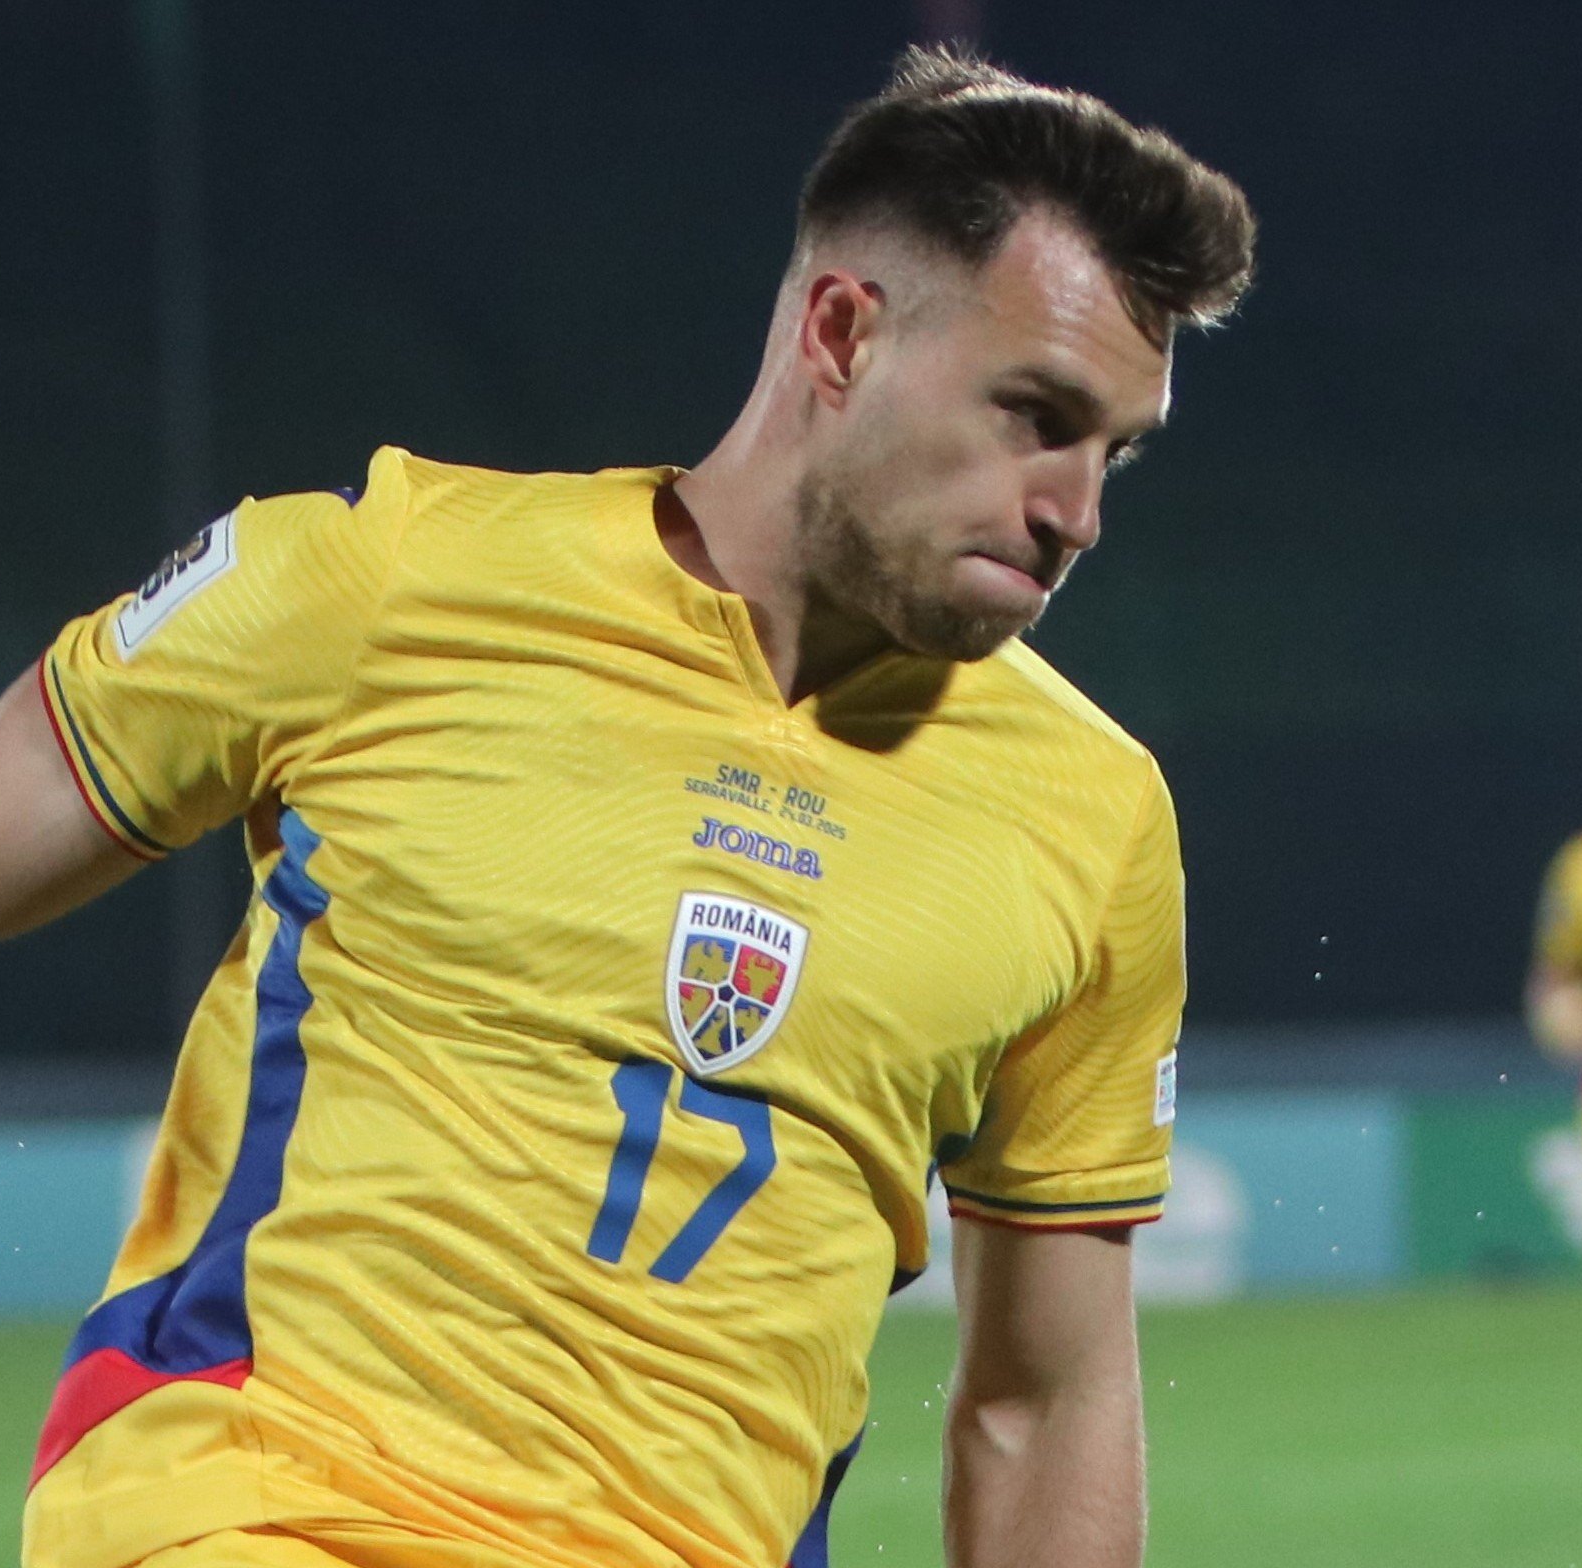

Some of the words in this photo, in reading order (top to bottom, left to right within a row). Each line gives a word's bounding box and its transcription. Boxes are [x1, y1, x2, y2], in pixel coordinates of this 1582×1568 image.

[717, 764, 760, 794] SMR
[785, 786, 825, 815] ROU
[690, 903, 791, 953] ROMÂNIA
[586, 1057, 778, 1284] 17
